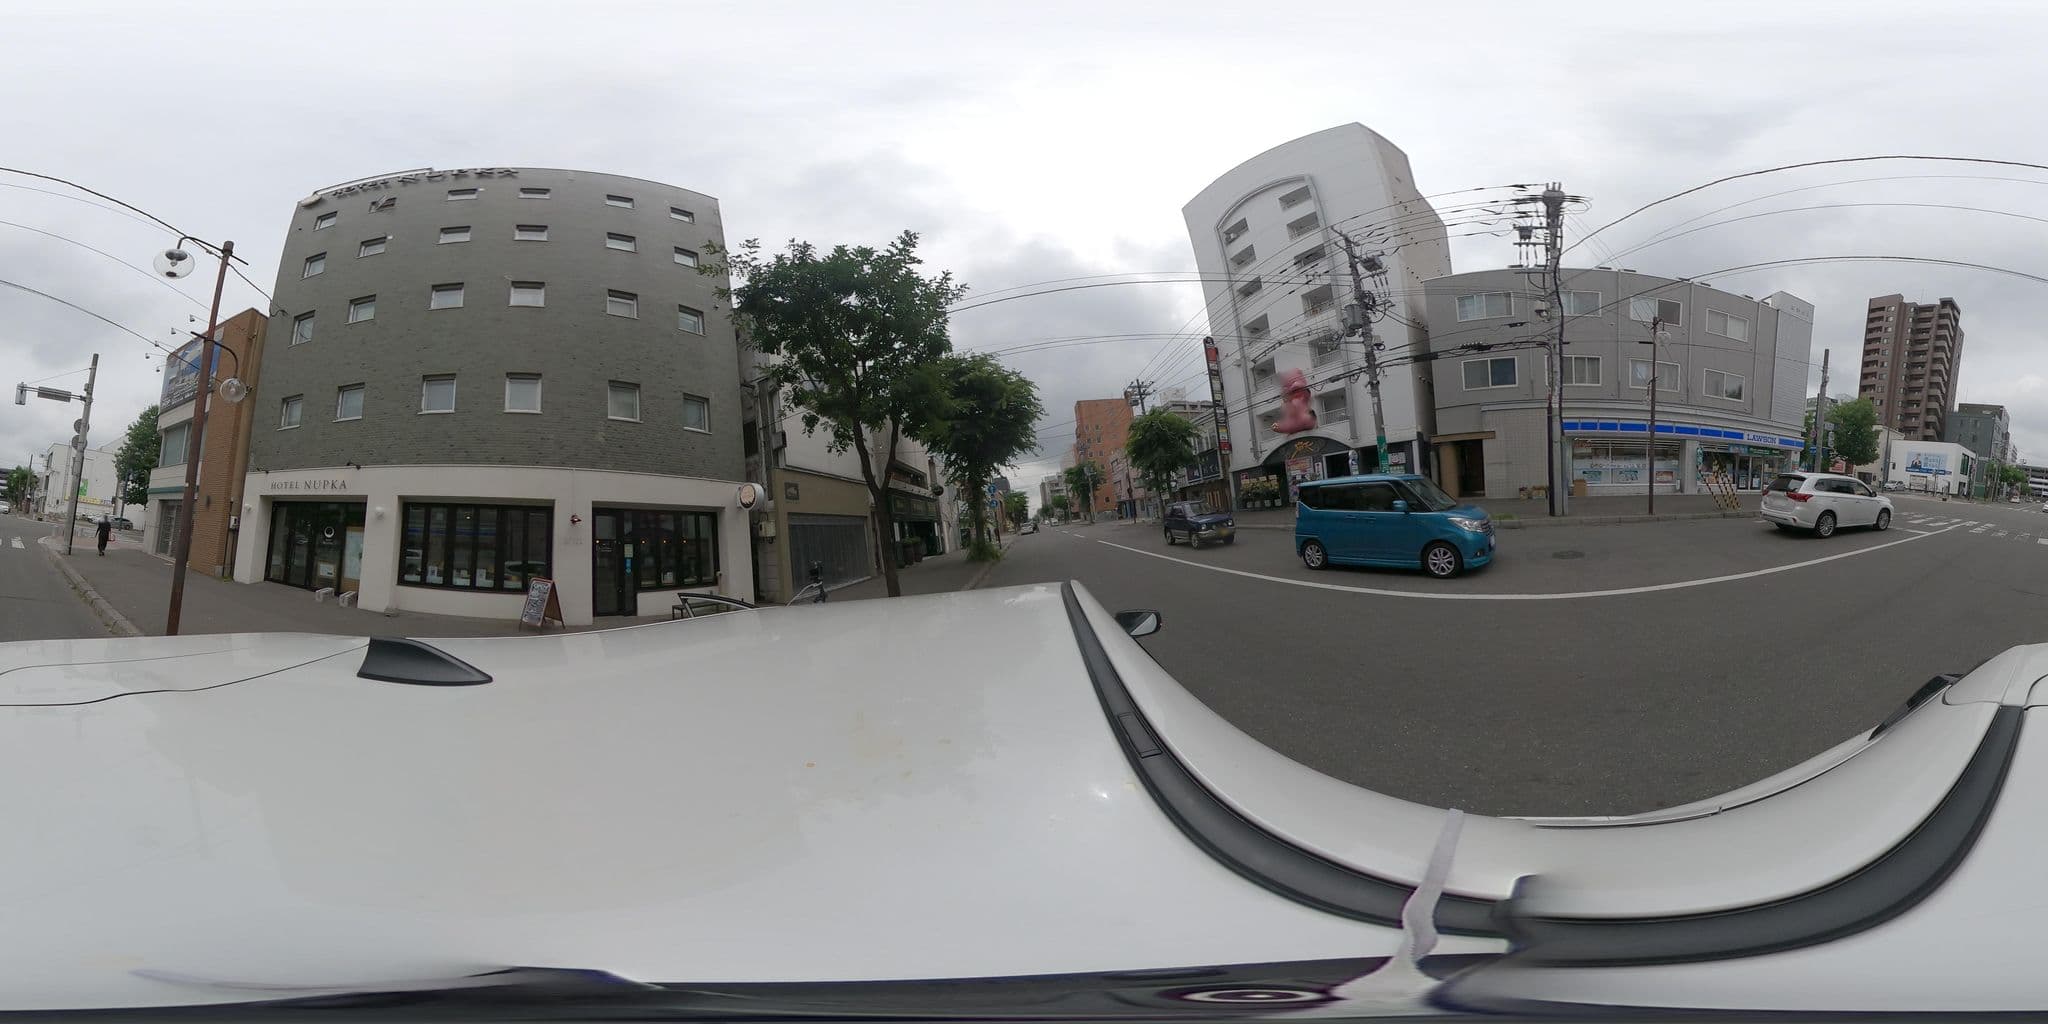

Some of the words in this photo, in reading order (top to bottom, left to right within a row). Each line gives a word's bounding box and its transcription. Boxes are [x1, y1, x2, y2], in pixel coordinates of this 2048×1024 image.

[1747, 433, 1777, 445] LAWSON
[270, 480, 300, 490] HOTEL
[304, 479, 347, 490] NUPKA
